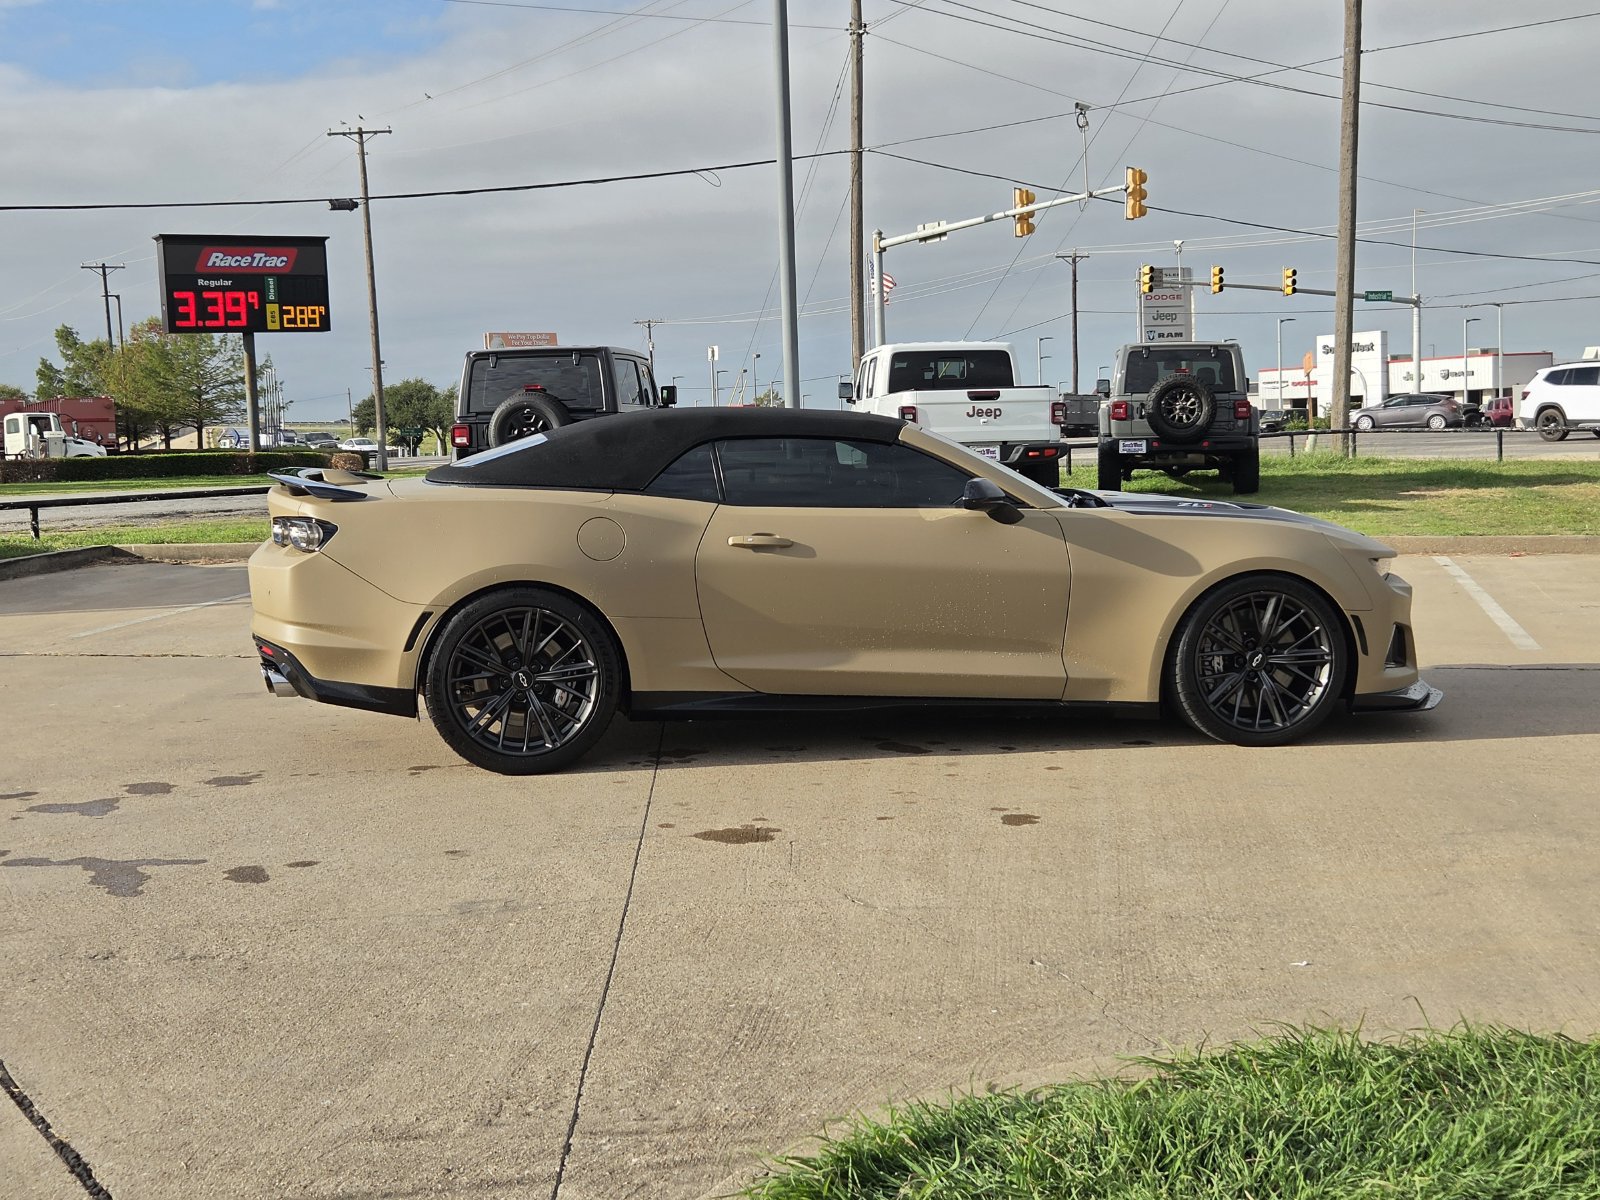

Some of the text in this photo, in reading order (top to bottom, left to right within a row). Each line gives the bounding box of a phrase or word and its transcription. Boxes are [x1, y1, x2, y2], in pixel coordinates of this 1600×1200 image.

[207, 252, 288, 268] RaceTrac
[197, 278, 233, 288] Regular
[1152, 309, 1177, 323] Jeep
[965, 405, 1003, 420] Jeep
